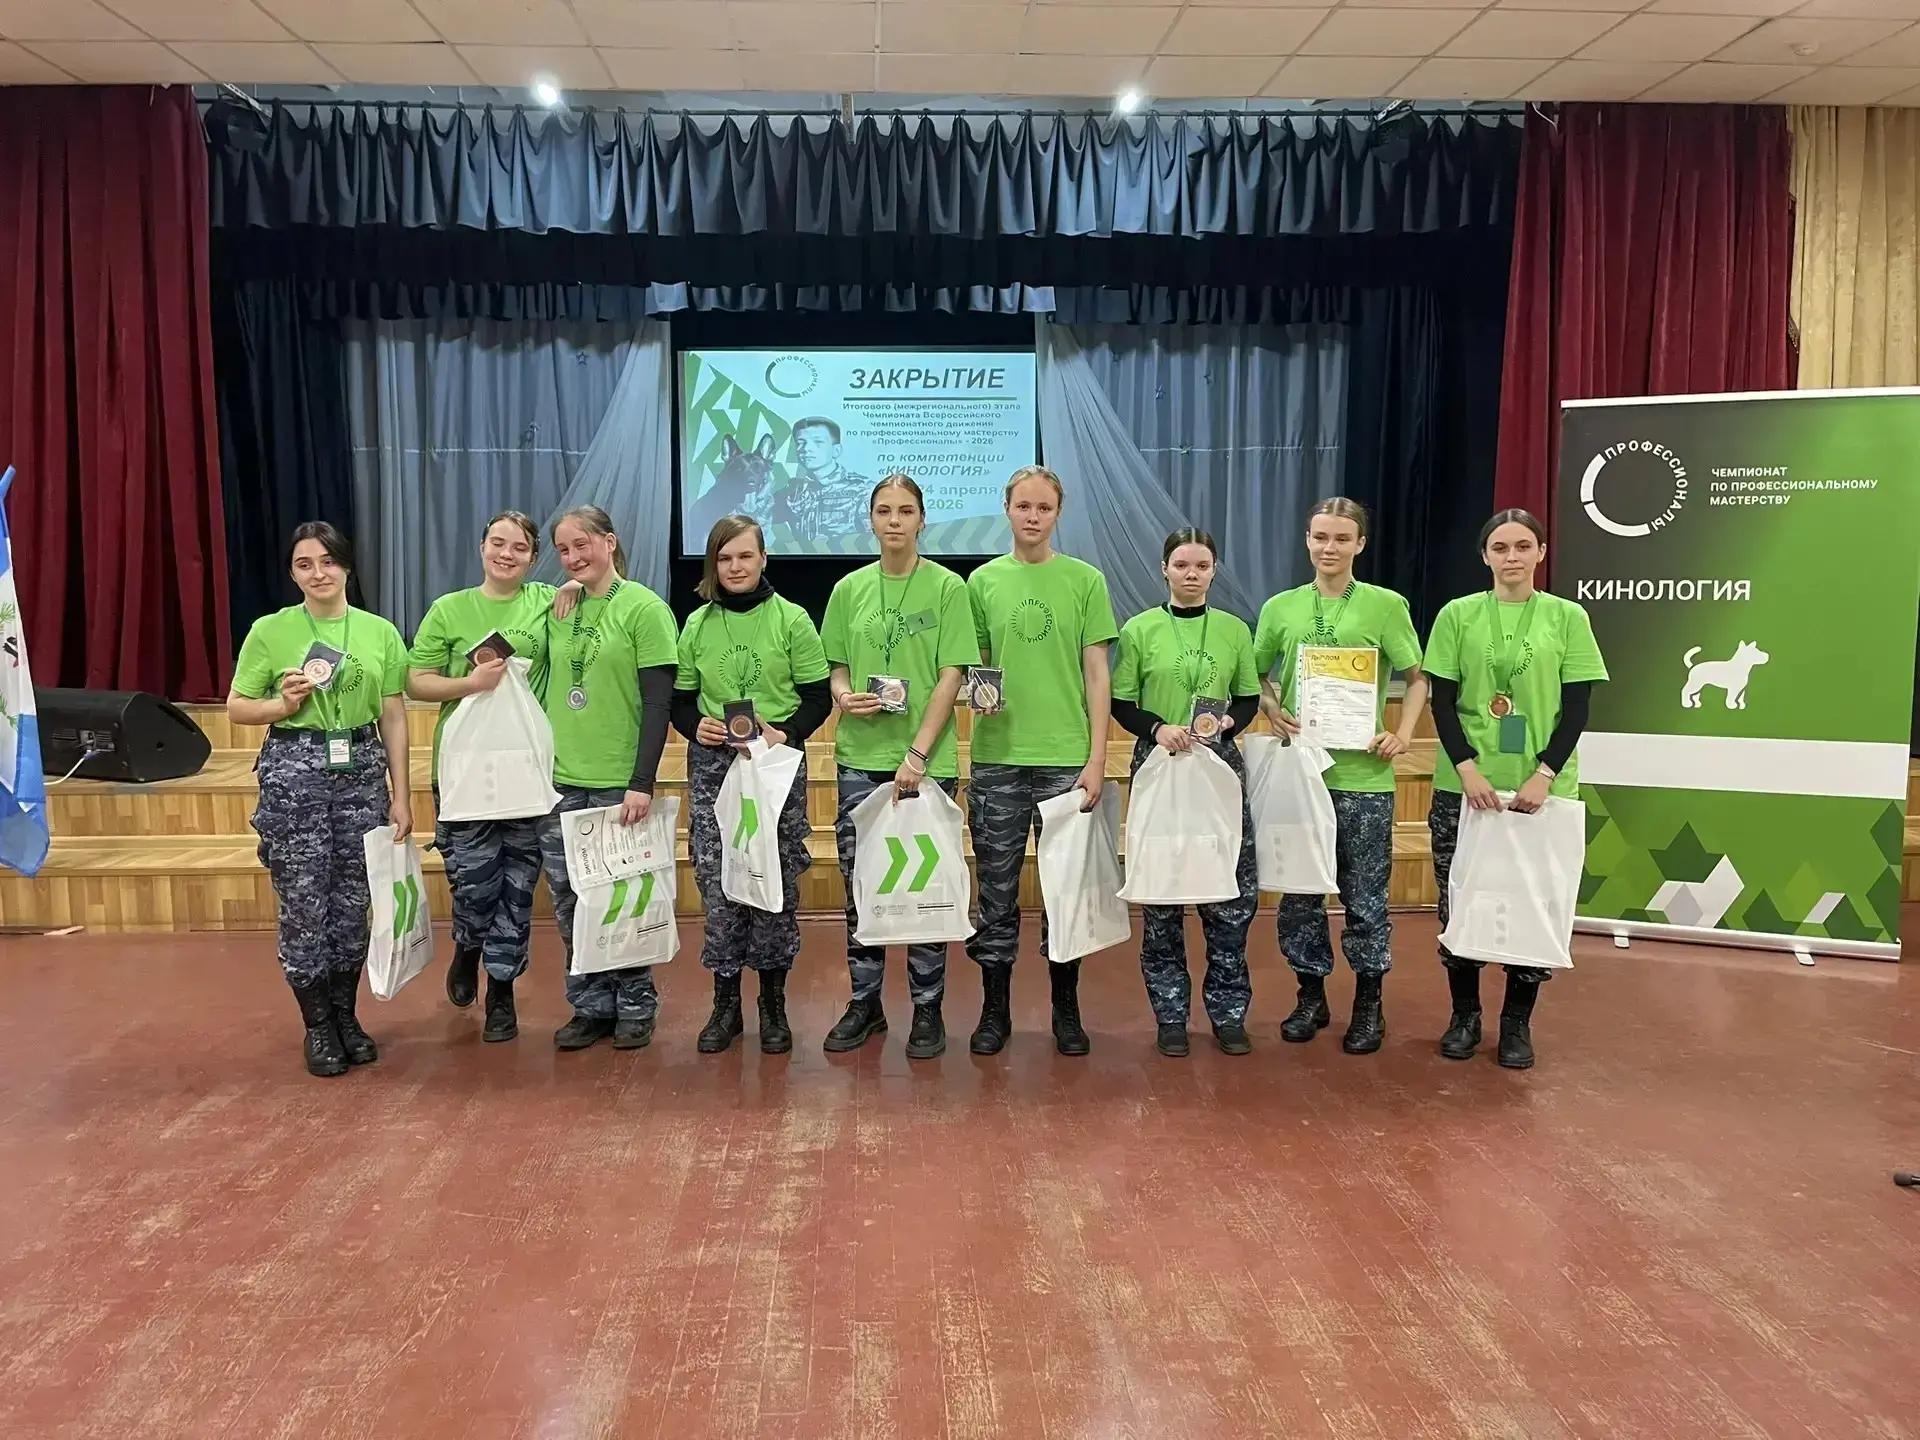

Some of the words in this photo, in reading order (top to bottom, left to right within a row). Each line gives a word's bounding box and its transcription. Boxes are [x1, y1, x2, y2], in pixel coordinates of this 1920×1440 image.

[849, 368, 1005, 389] ЗАКРЫТИЕ
[893, 403, 991, 411] (межрегионального)
[923, 411, 1001, 419] Всероссийского
[860, 429, 961, 437] профессиональному
[964, 429, 1019, 437] мастерству
[877, 454, 895, 462] по
[900, 454, 1004, 463] компетенции
[878, 465, 991, 476] «КИНОЛОГИЯ»
[1711, 467, 1788, 477] ЧЕМПИОНАТ
[1604, 440, 1688, 531] ПРОФЕССИОНАЛЫ
[1710, 482, 1730, 491] ПО
[1731, 480, 1878, 491] ПРОФЕССИОНАЛЬНОМУ
[940, 486, 997, 497] апреля
[927, 499, 964, 510] 2026
[1710, 495, 1791, 506] МАСТЕРСТВУ
[1577, 579, 1751, 600] КИНОЛОГИЯ
